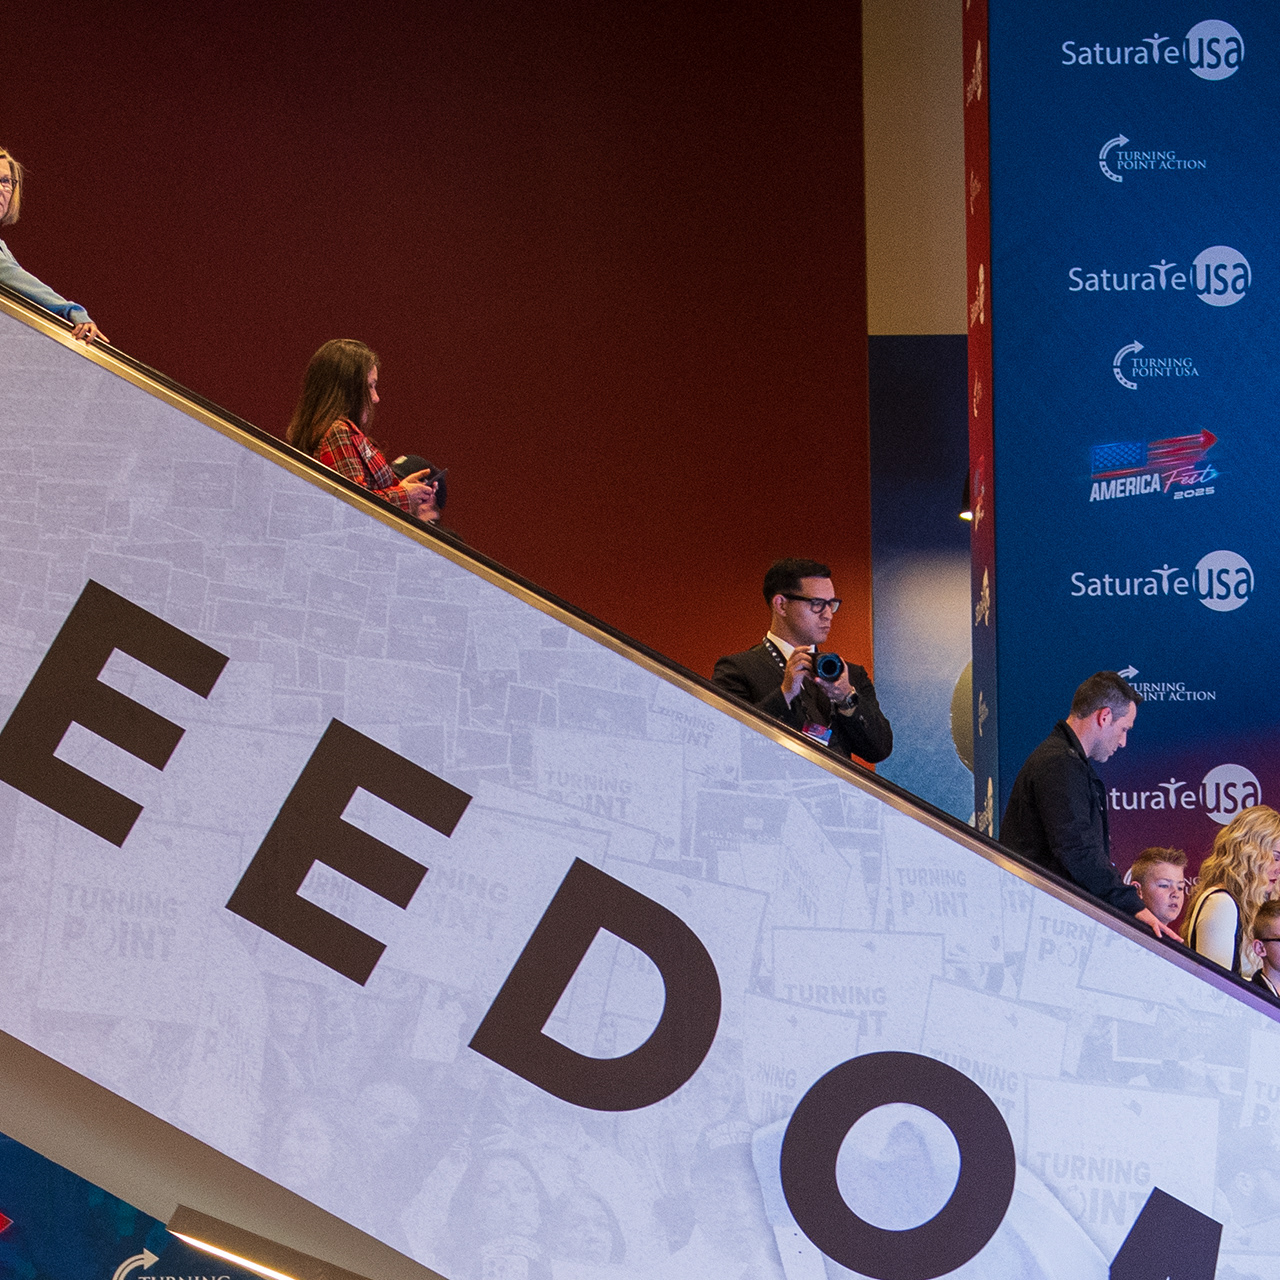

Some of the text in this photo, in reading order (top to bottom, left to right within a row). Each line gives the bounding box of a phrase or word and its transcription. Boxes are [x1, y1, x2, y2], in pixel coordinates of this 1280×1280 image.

[1116, 151, 1175, 161] TURNING
[1118, 160, 1207, 170] POINT ACTION
[1131, 357, 1193, 369] TURNING
[1132, 368, 1199, 377] POINT USA
[1089, 464, 1218, 502] AMERICA Fest
[1173, 486, 1215, 500] 2025
[1138, 691, 1217, 702] INT ACTION
